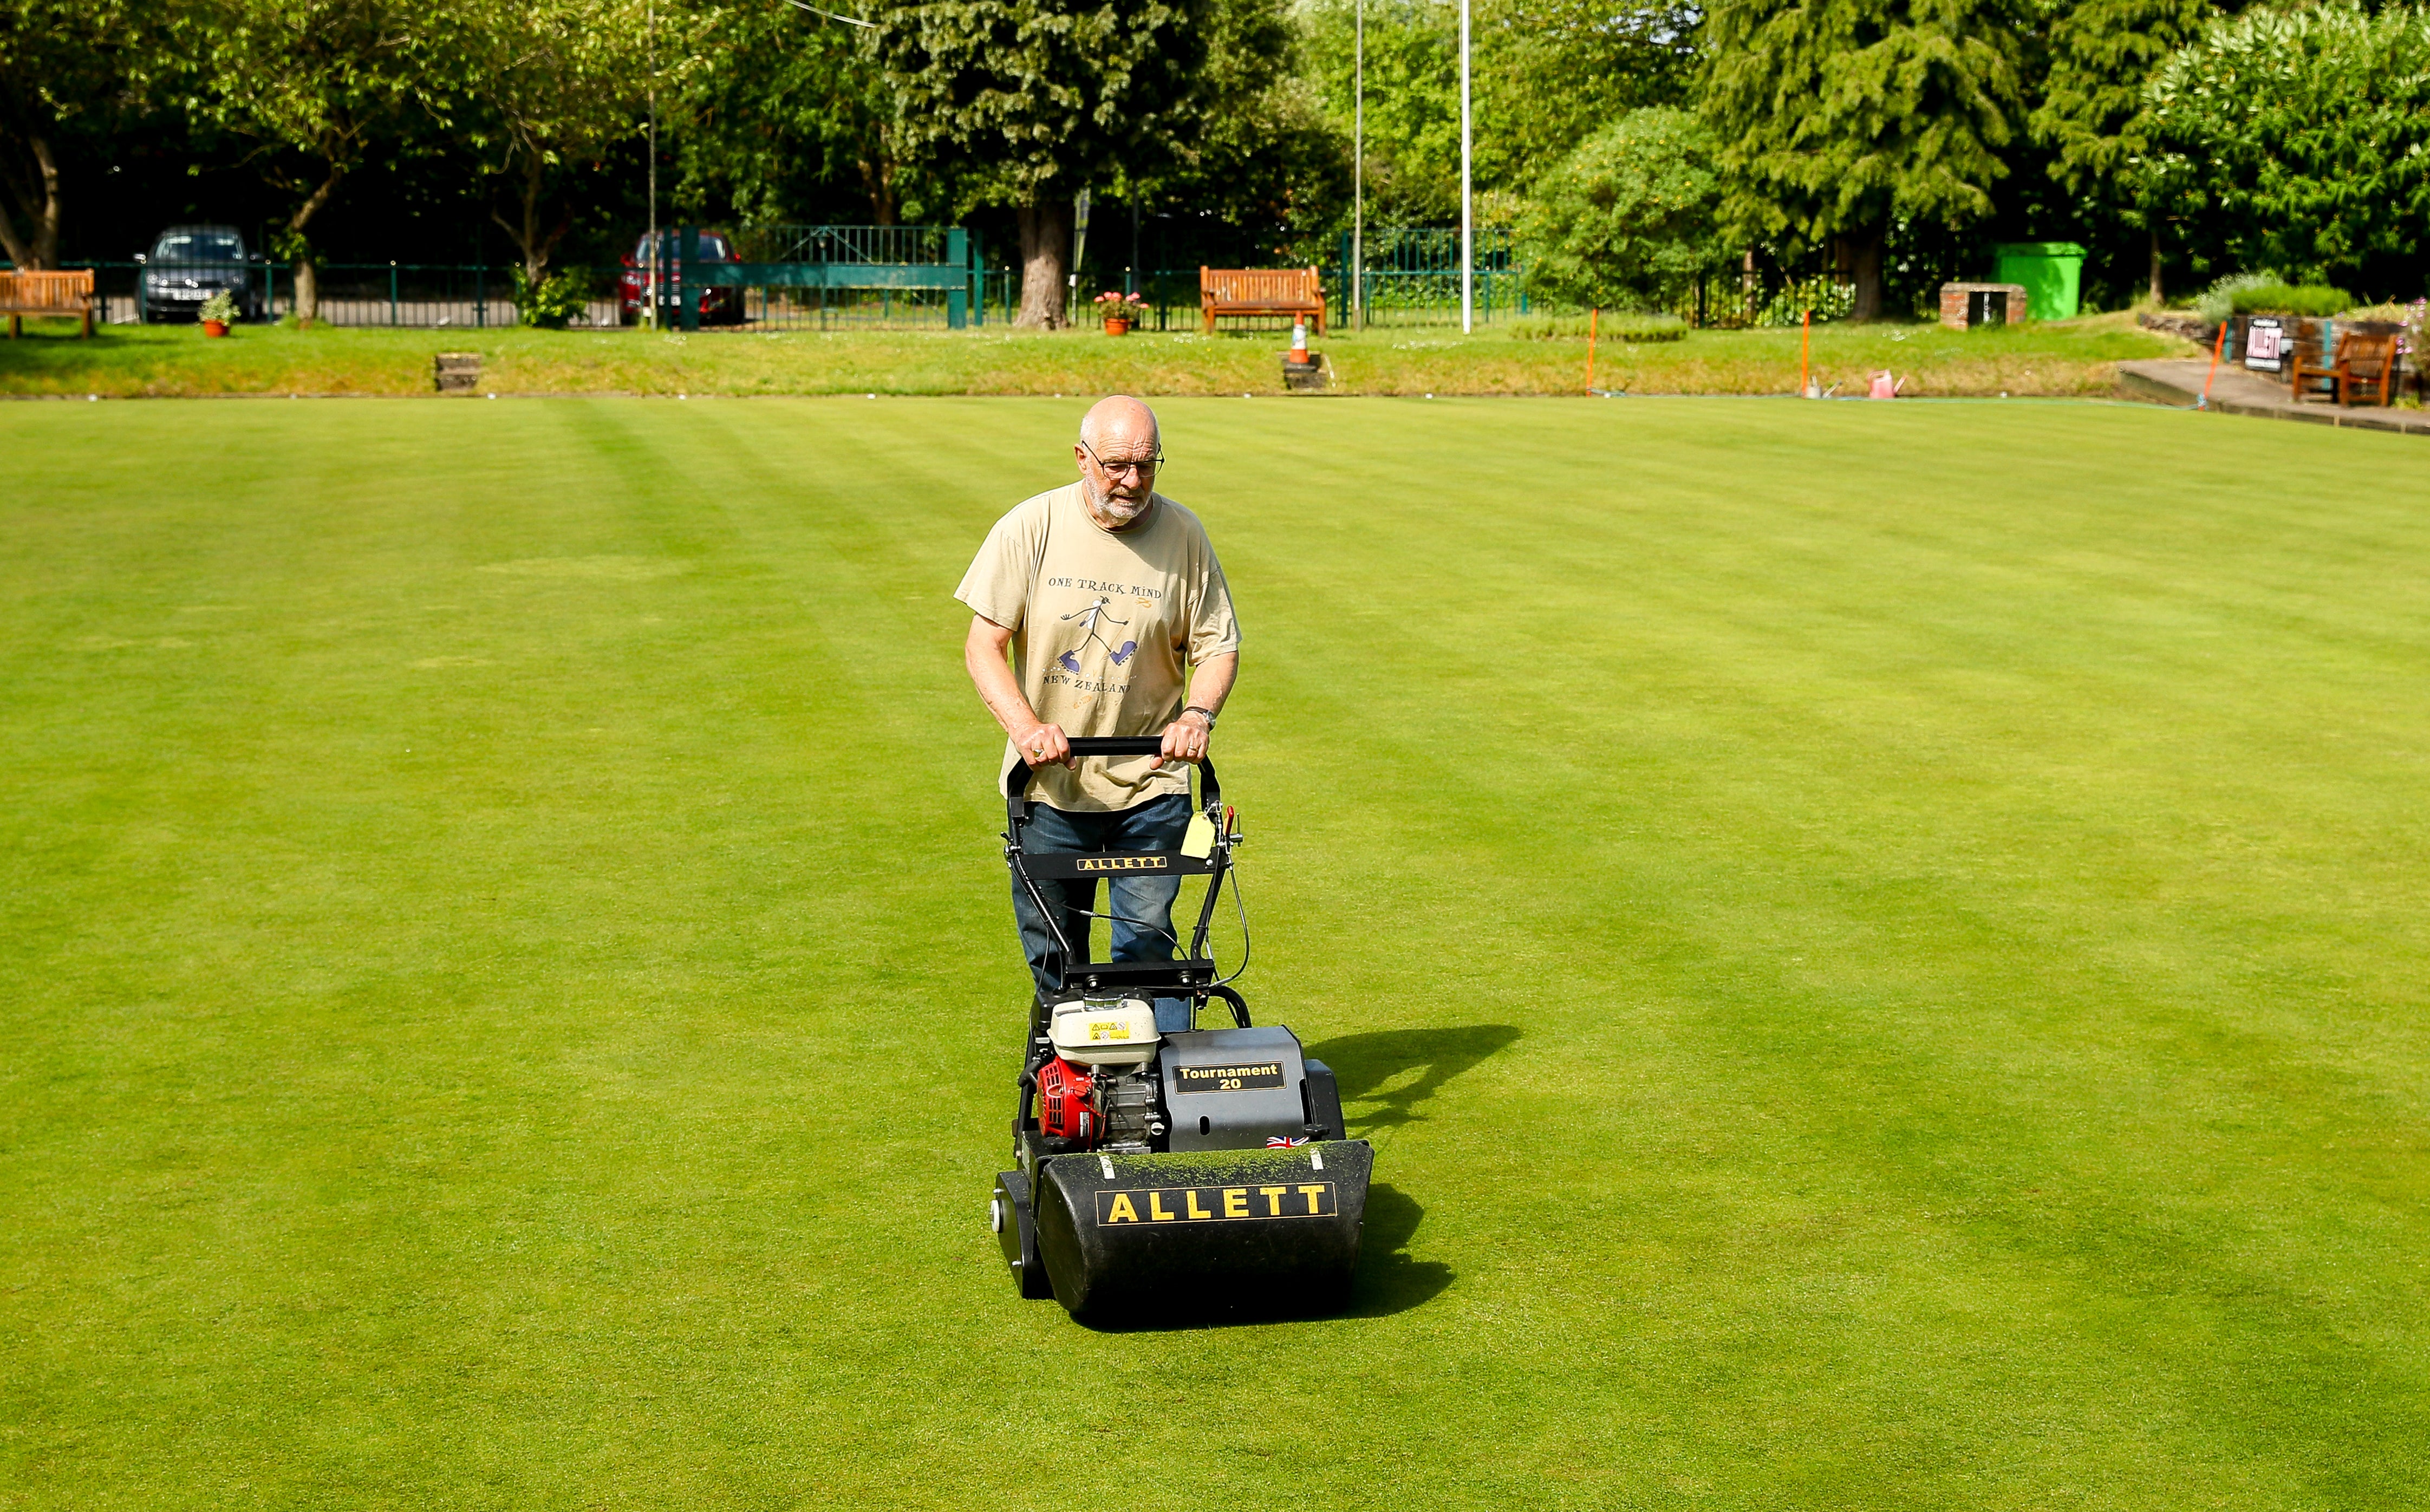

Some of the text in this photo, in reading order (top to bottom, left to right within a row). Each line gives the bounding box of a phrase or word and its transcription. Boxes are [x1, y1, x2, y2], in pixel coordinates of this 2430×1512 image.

[1048, 578, 1072, 587] ONE
[1077, 579, 1126, 595] TRACK
[1043, 675, 1131, 694] NEW ZEALAND
[1084, 858, 1160, 870] ALLETT
[1180, 1064, 1278, 1079] Tournament
[1220, 1078, 1242, 1090] 20
[1108, 1185, 1325, 1223] ALLETT
